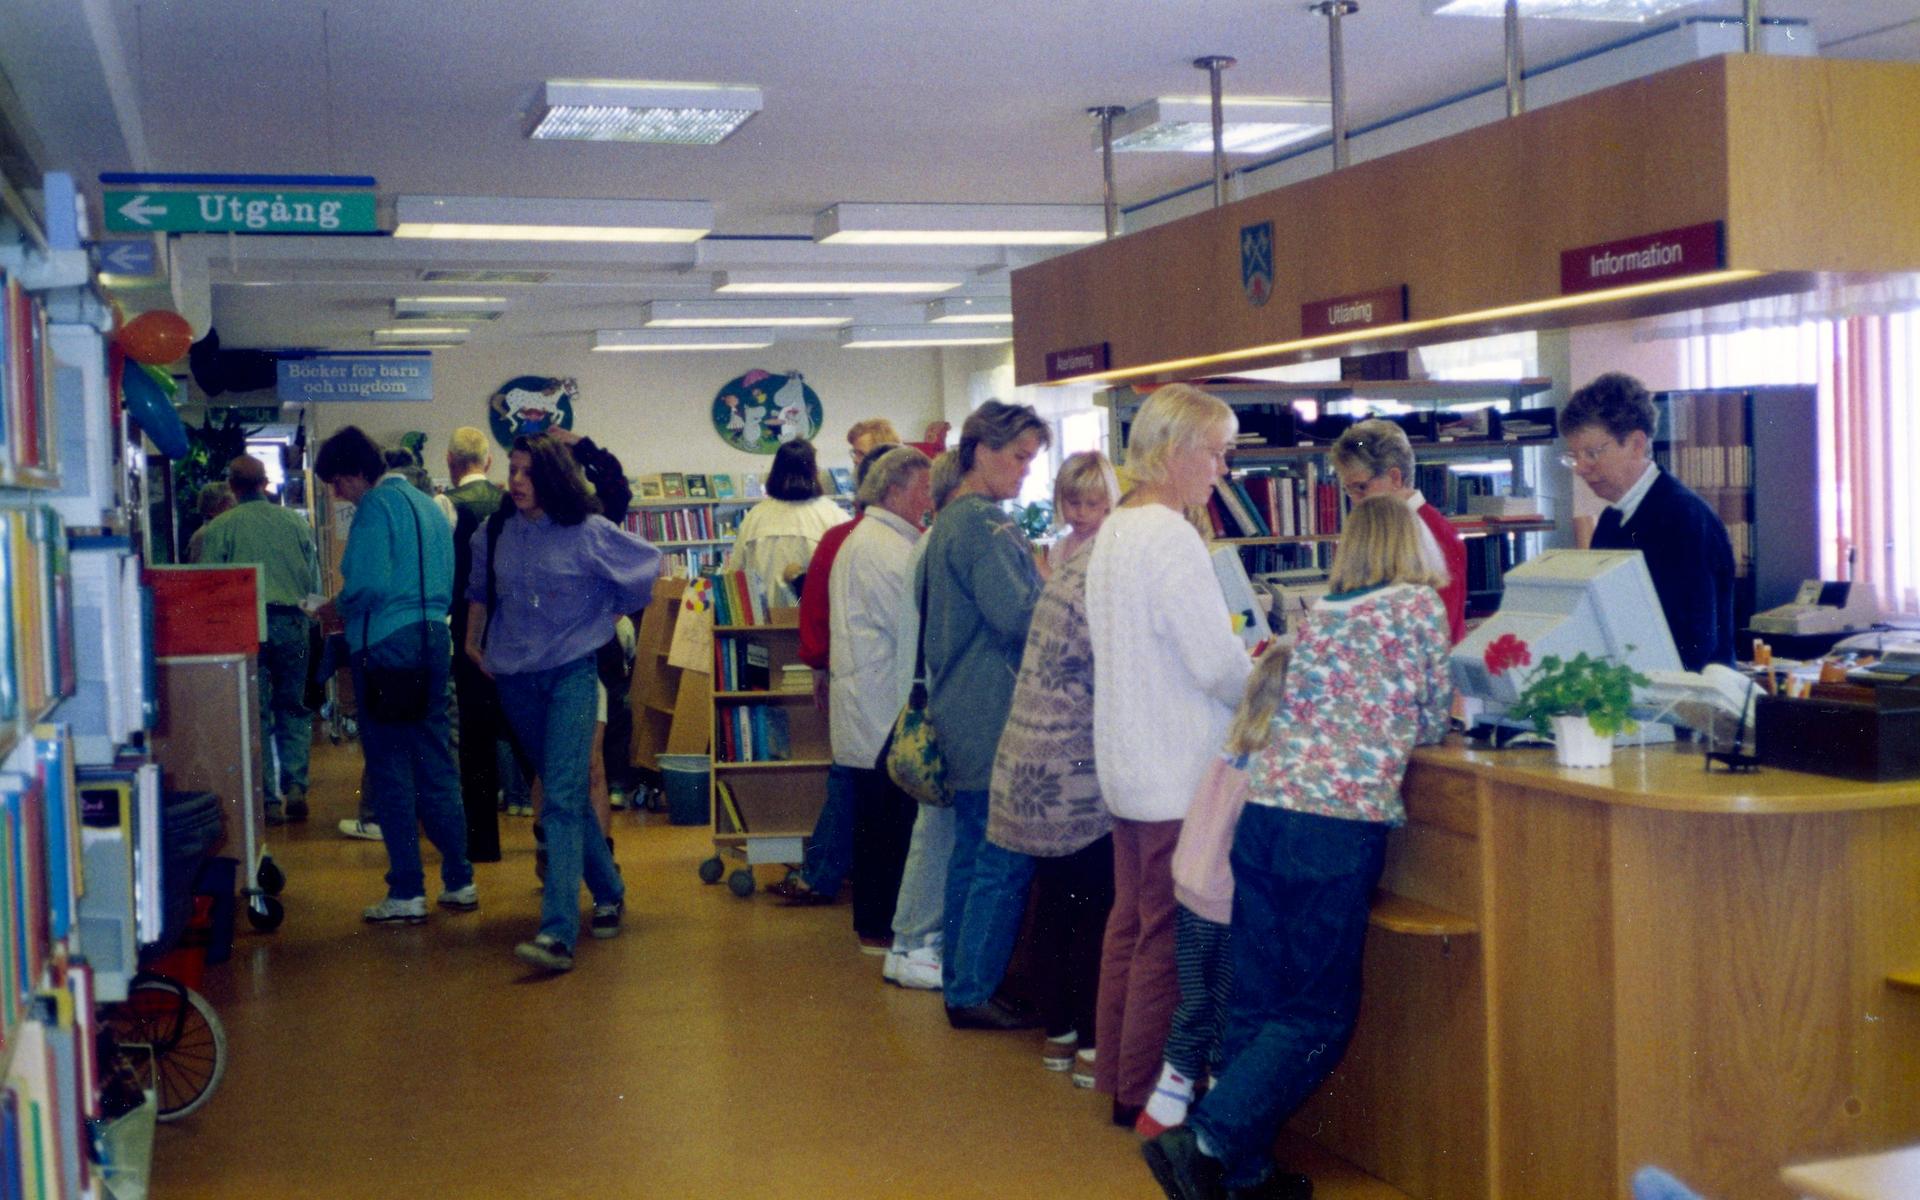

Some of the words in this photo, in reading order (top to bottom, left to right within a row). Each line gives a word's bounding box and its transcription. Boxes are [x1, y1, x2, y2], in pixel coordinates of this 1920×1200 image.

[197, 194, 342, 229] Utgång
[1590, 242, 1683, 278] Information
[289, 364, 347, 378] Böcker
[352, 364, 376, 377] för
[380, 363, 419, 377] barn
[304, 380, 334, 393] och
[338, 380, 407, 397] ungdom
